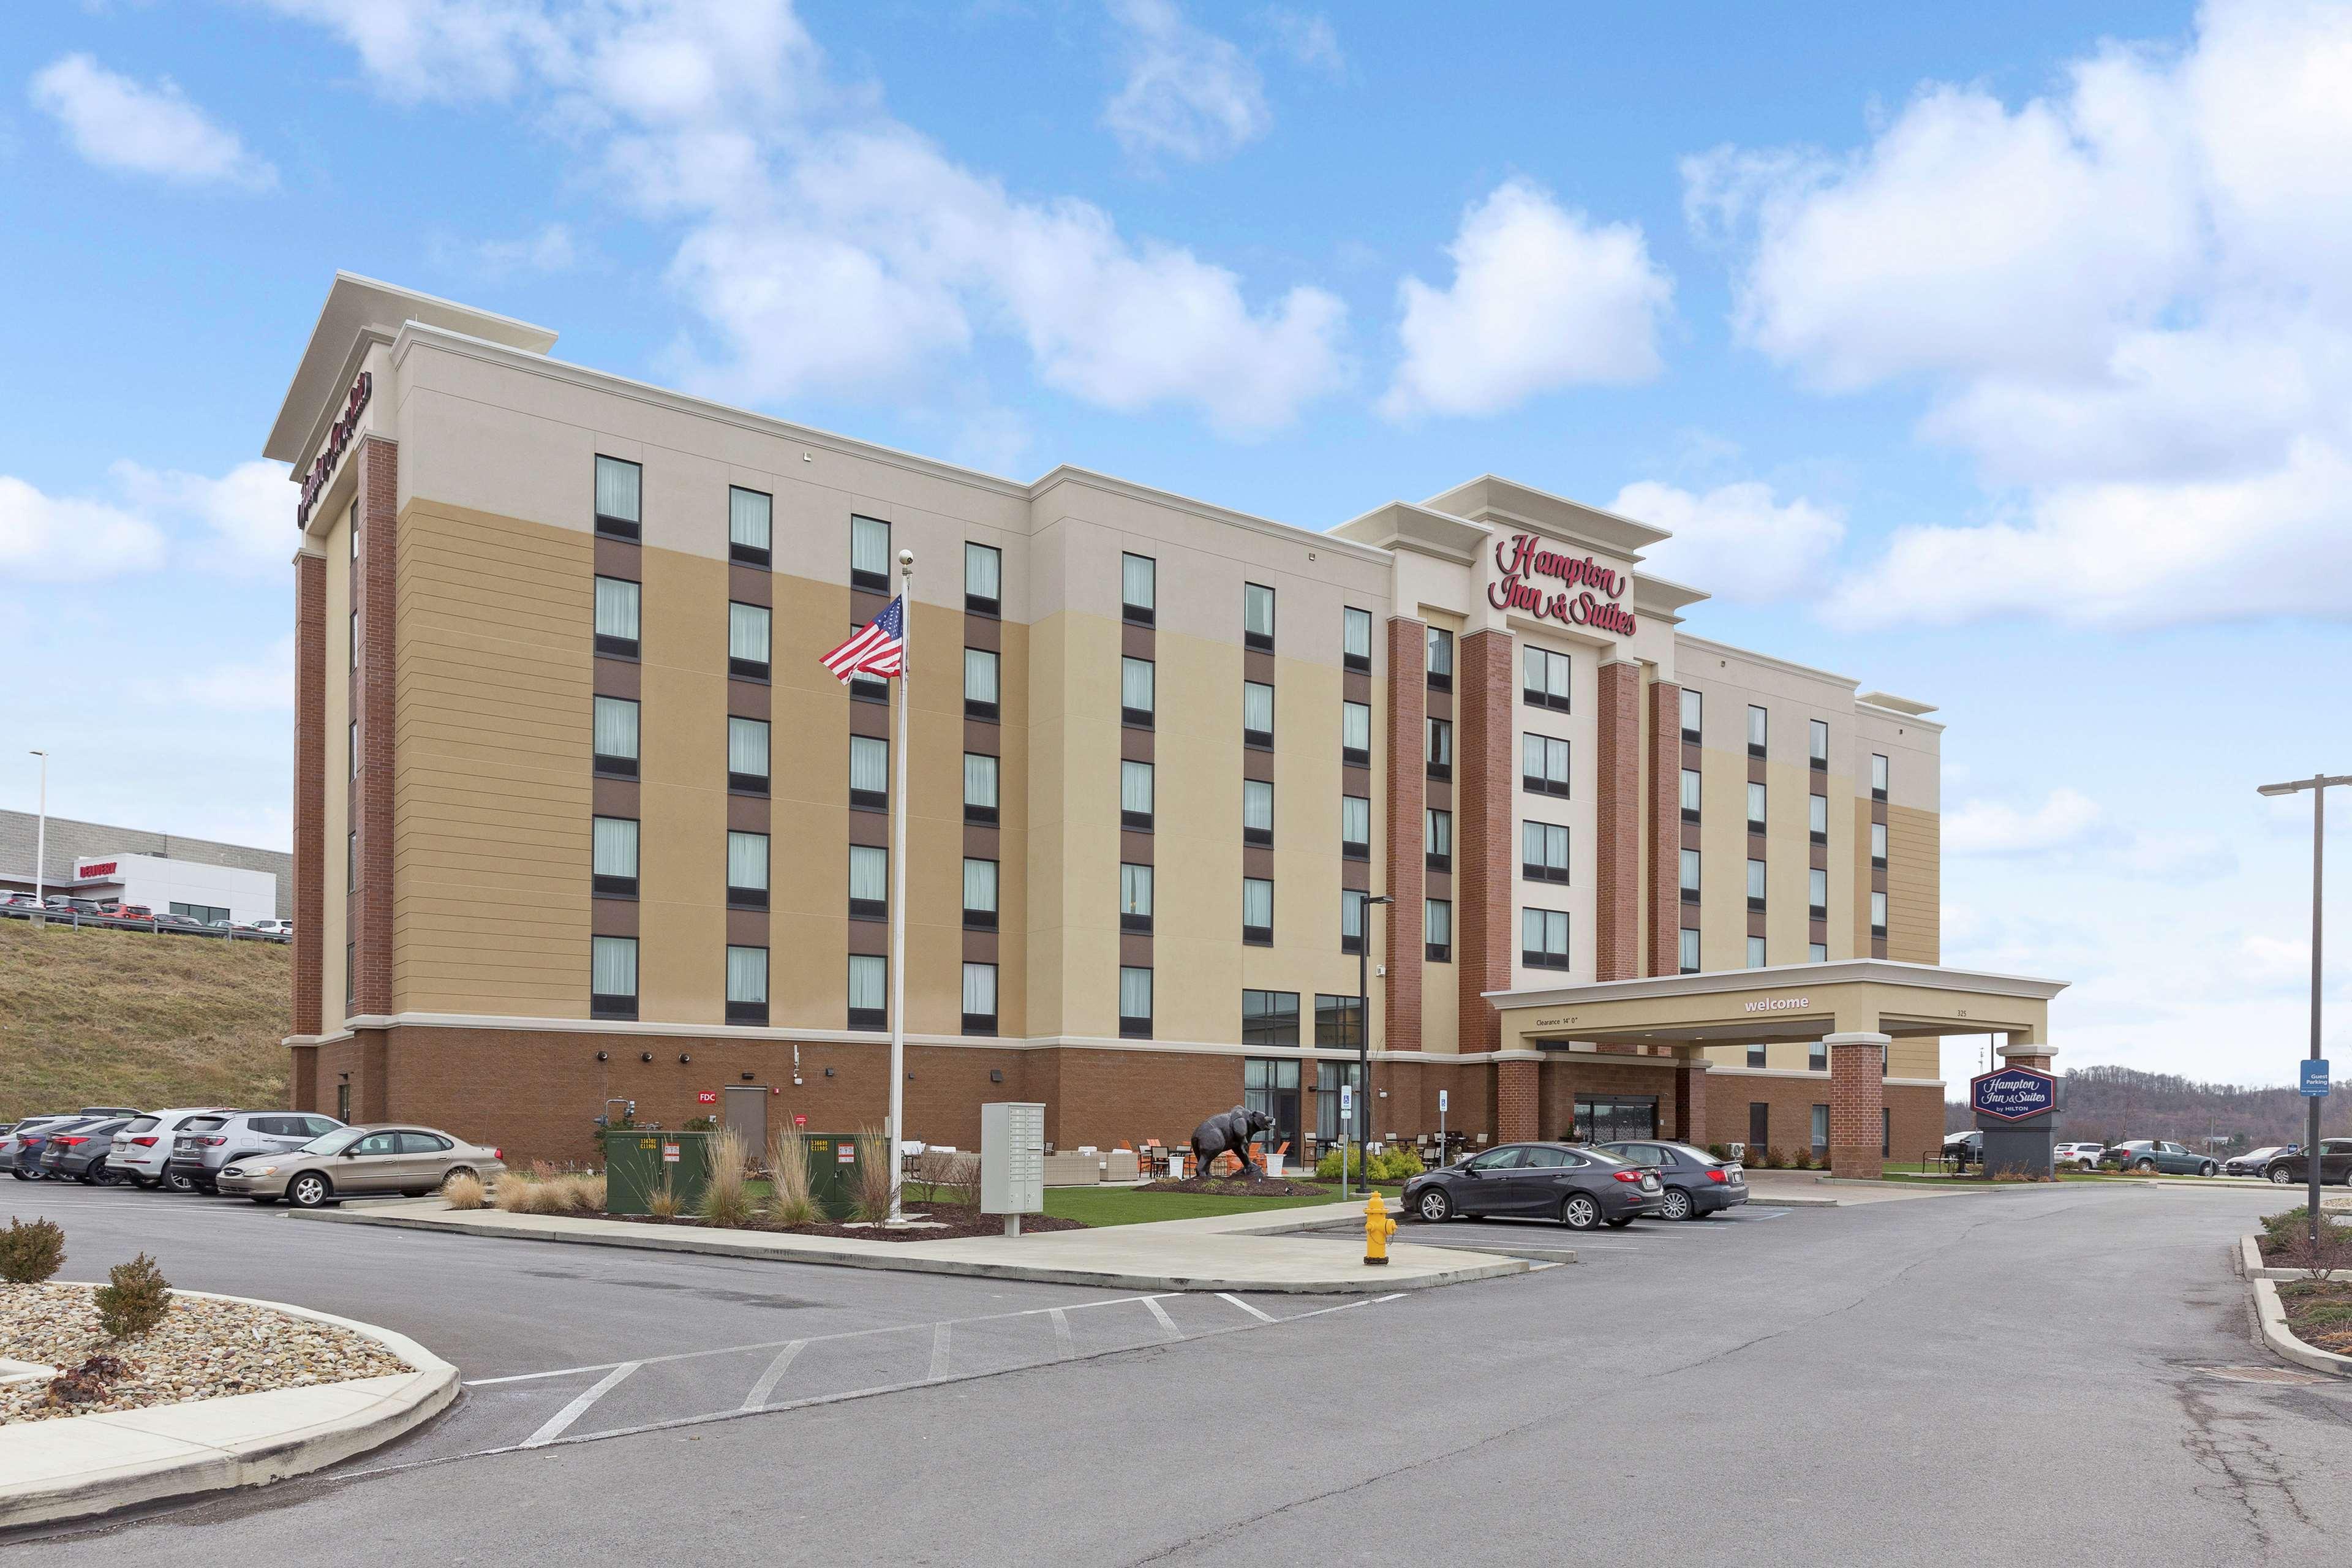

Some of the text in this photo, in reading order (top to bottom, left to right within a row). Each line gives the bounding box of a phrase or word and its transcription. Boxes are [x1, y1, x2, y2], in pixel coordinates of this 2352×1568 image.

[1495, 534, 1626, 598] Hampton
[1488, 574, 1637, 636] Inn & Suites
[80, 862, 117, 878] DELIVERY
[1744, 997, 1809, 1012] welcome
[1983, 1078, 2040, 1093] Hampton
[1981, 1091, 2045, 1104] Inn & Suites
